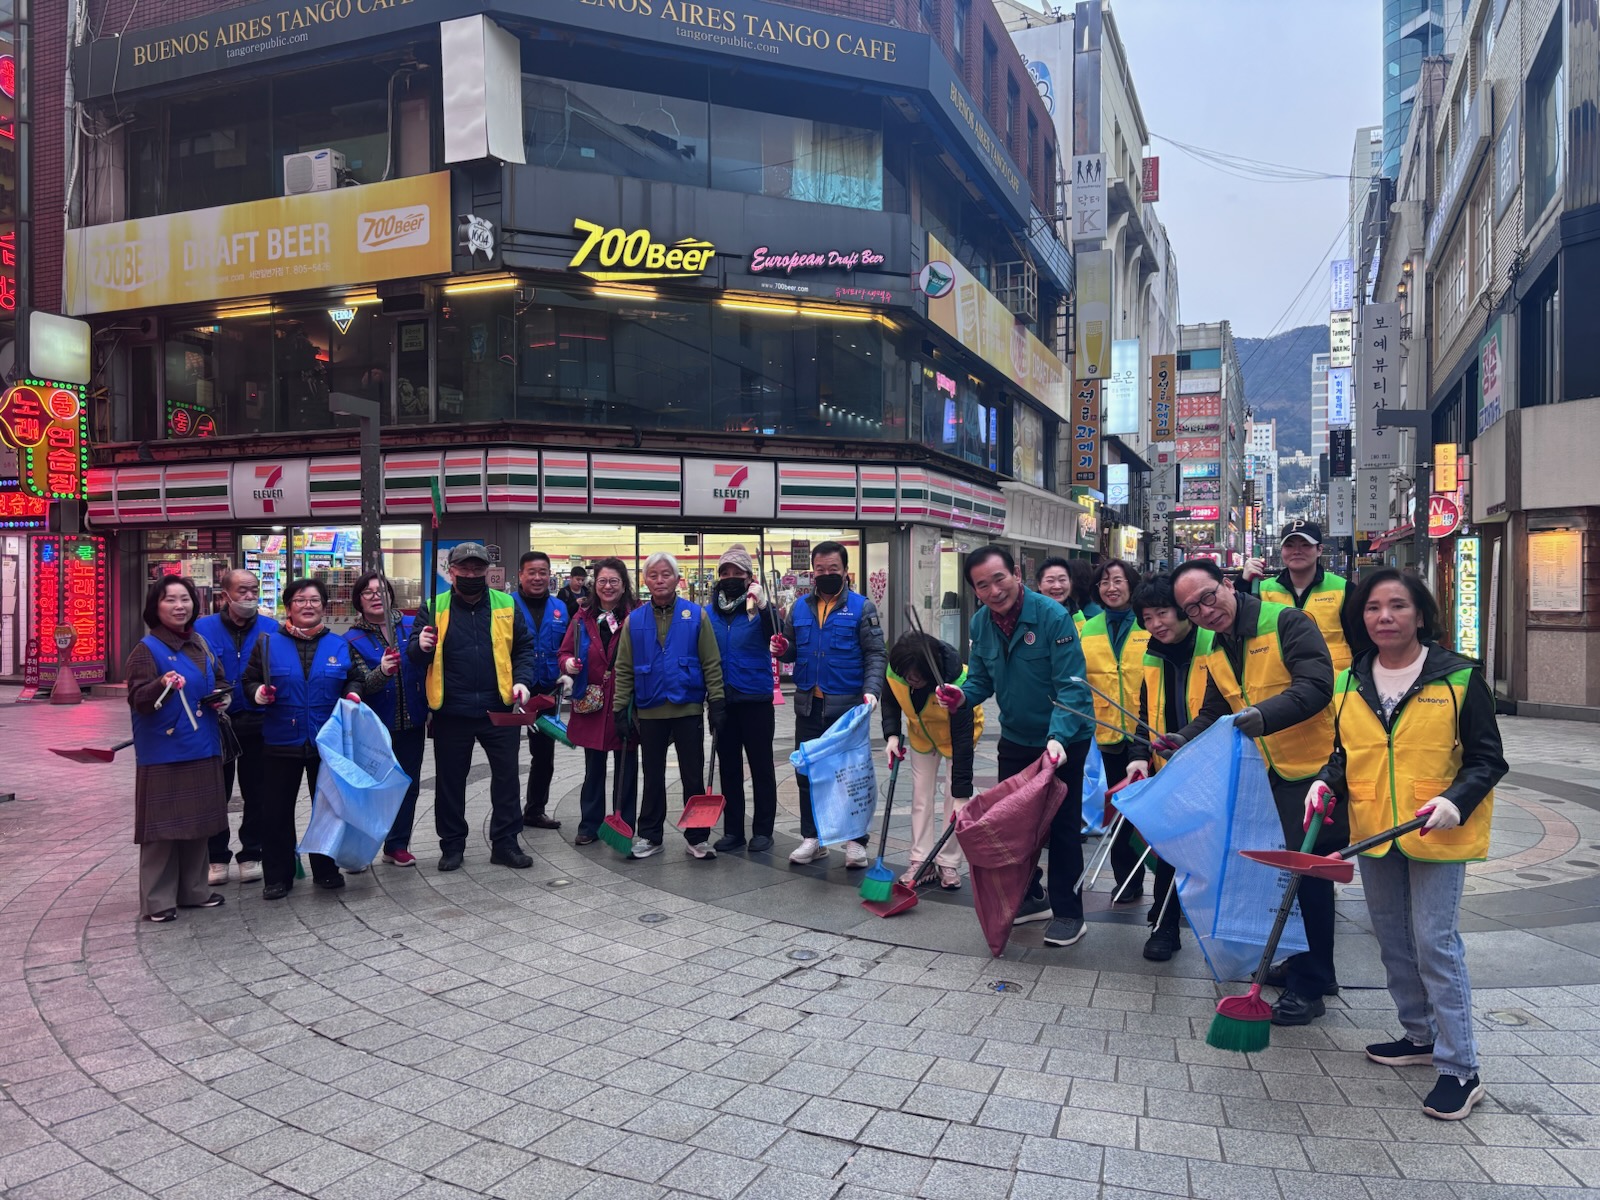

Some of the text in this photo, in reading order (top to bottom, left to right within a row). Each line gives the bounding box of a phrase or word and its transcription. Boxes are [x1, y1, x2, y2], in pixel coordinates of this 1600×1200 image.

[133, 30, 209, 66] BUENOS
[214, 15, 272, 48] AIRES
[277, 0, 351, 34] TANGO
[226, 31, 308, 59] tangorepublic.com
[660, 0, 736, 32] AIRES
[743, 15, 830, 50] TANGO
[837, 34, 897, 63] CAFE
[676, 26, 780, 54] tangorepublic.com
[950, 81, 974, 130] BUENOS
[973, 119, 990, 153] AIRES
[989, 141, 1008, 177] TANGO
[1006, 167, 1019, 194] CAFE
[1078, 194, 1100, 207] 닥터
[362, 214, 425, 243] 700Beer
[1077, 209, 1101, 235] K
[183, 222, 331, 271] DRAFT BEER
[471, 229, 489, 246] 1664
[567, 218, 716, 271] 700Beer
[750, 246, 885, 274] European Draft Beer
[760, 281, 809, 293] www.700beer.com
[331, 309, 355, 321] TERRA
[1332, 329, 1351, 337] Tanning
[1110, 370, 1136, 384] 로온
[13, 392, 40, 440] 노래
[1156, 402, 1170, 428] 과메기
[47, 427, 78, 494] 연습장
[1075, 425, 1097, 468] 과메기
[255, 465, 283, 512] 7
[713, 464, 748, 513] 7
[1291, 519, 1305, 532] P
[73, 560, 97, 654] 노래연습장
